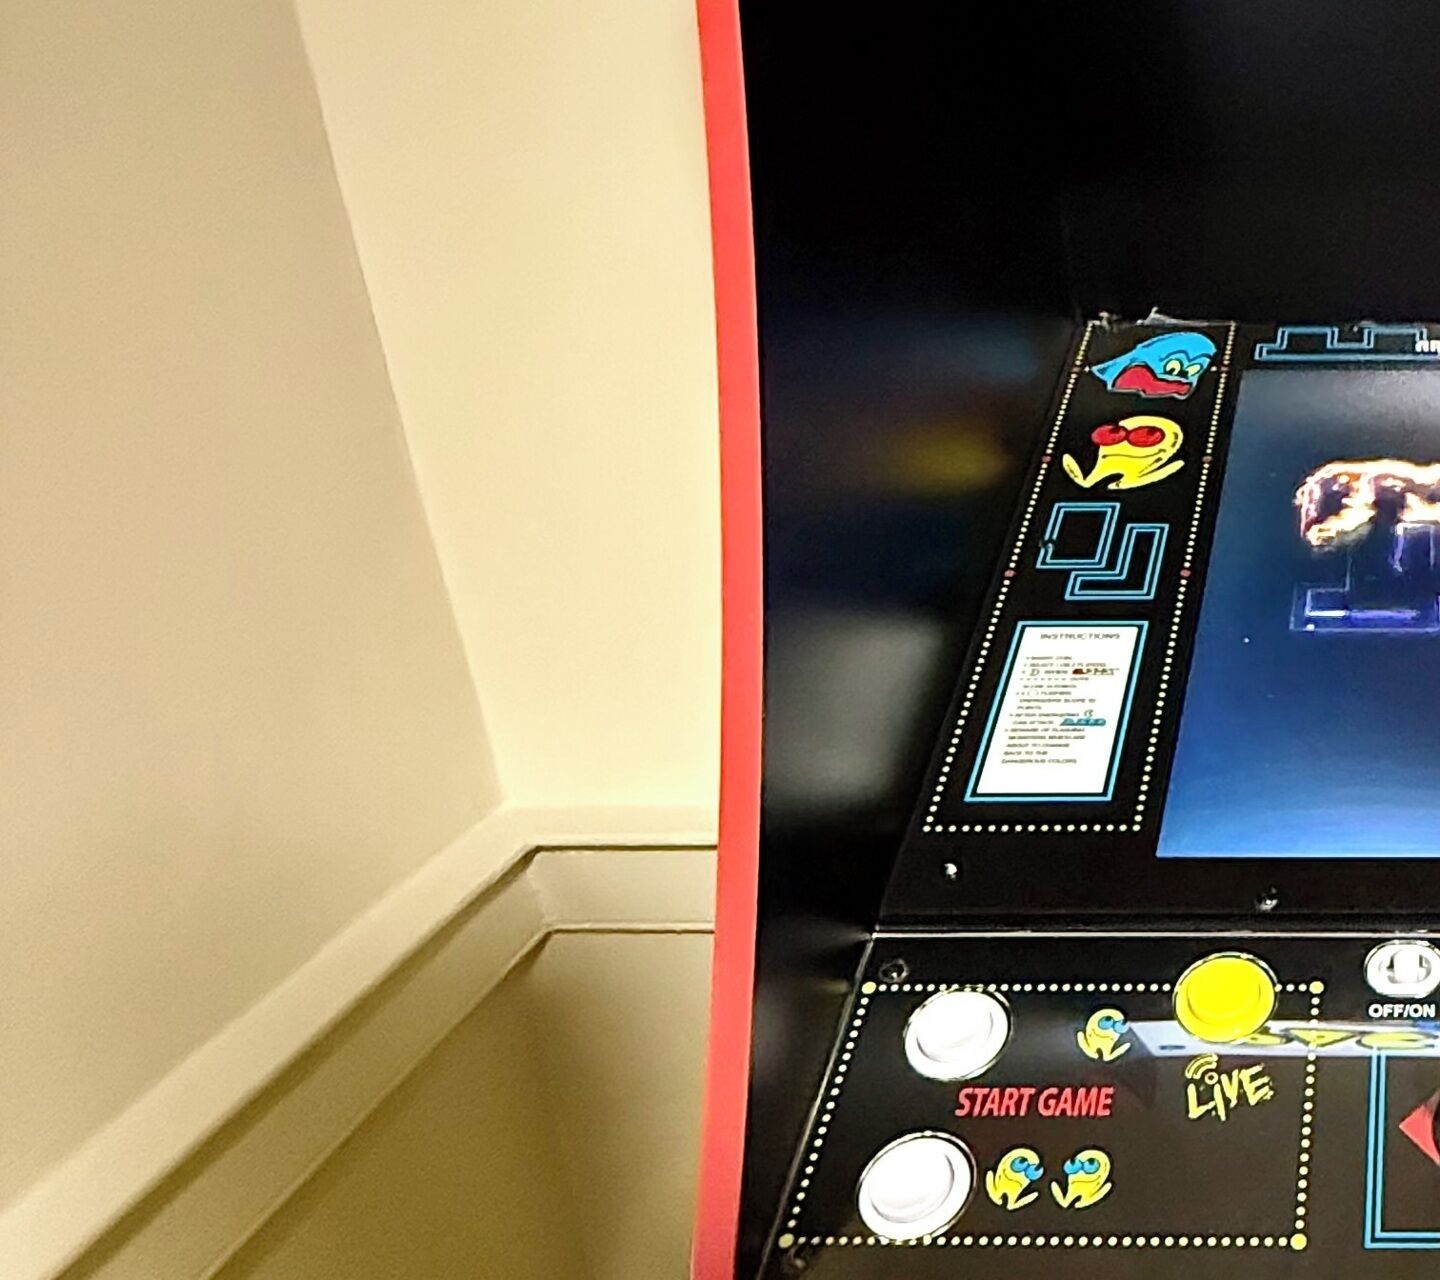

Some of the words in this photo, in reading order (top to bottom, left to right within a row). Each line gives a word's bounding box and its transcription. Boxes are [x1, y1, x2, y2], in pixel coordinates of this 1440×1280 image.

[1368, 1003, 1436, 1019] OFF/ON
[954, 1086, 1037, 1119] START
[1037, 1086, 1116, 1118] GAME
